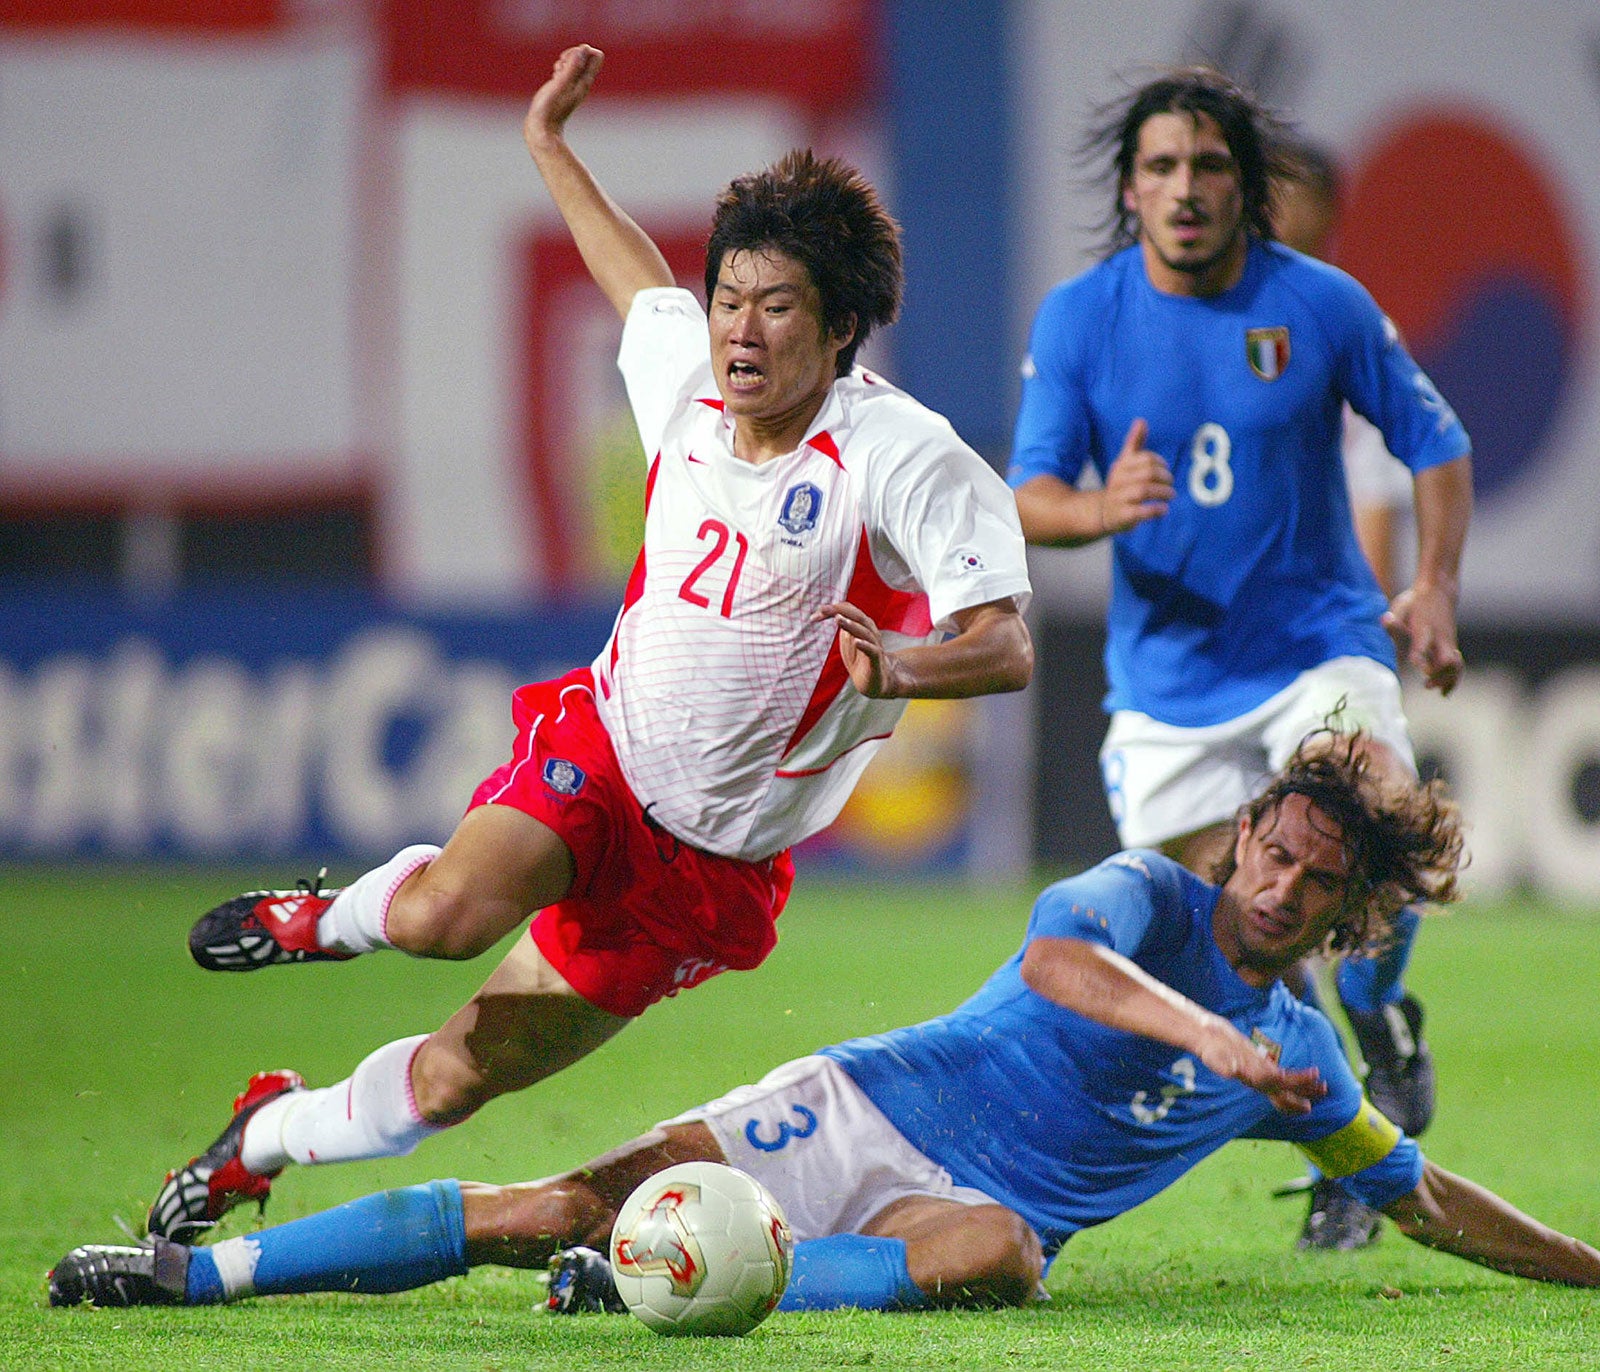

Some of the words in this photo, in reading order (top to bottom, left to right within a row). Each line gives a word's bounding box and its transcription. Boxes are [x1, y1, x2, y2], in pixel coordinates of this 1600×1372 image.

[1188, 423, 1234, 506] 8
[678, 518, 748, 619] 21
[745, 1104, 818, 1152] 3
[1130, 1057, 1196, 1125] 3
